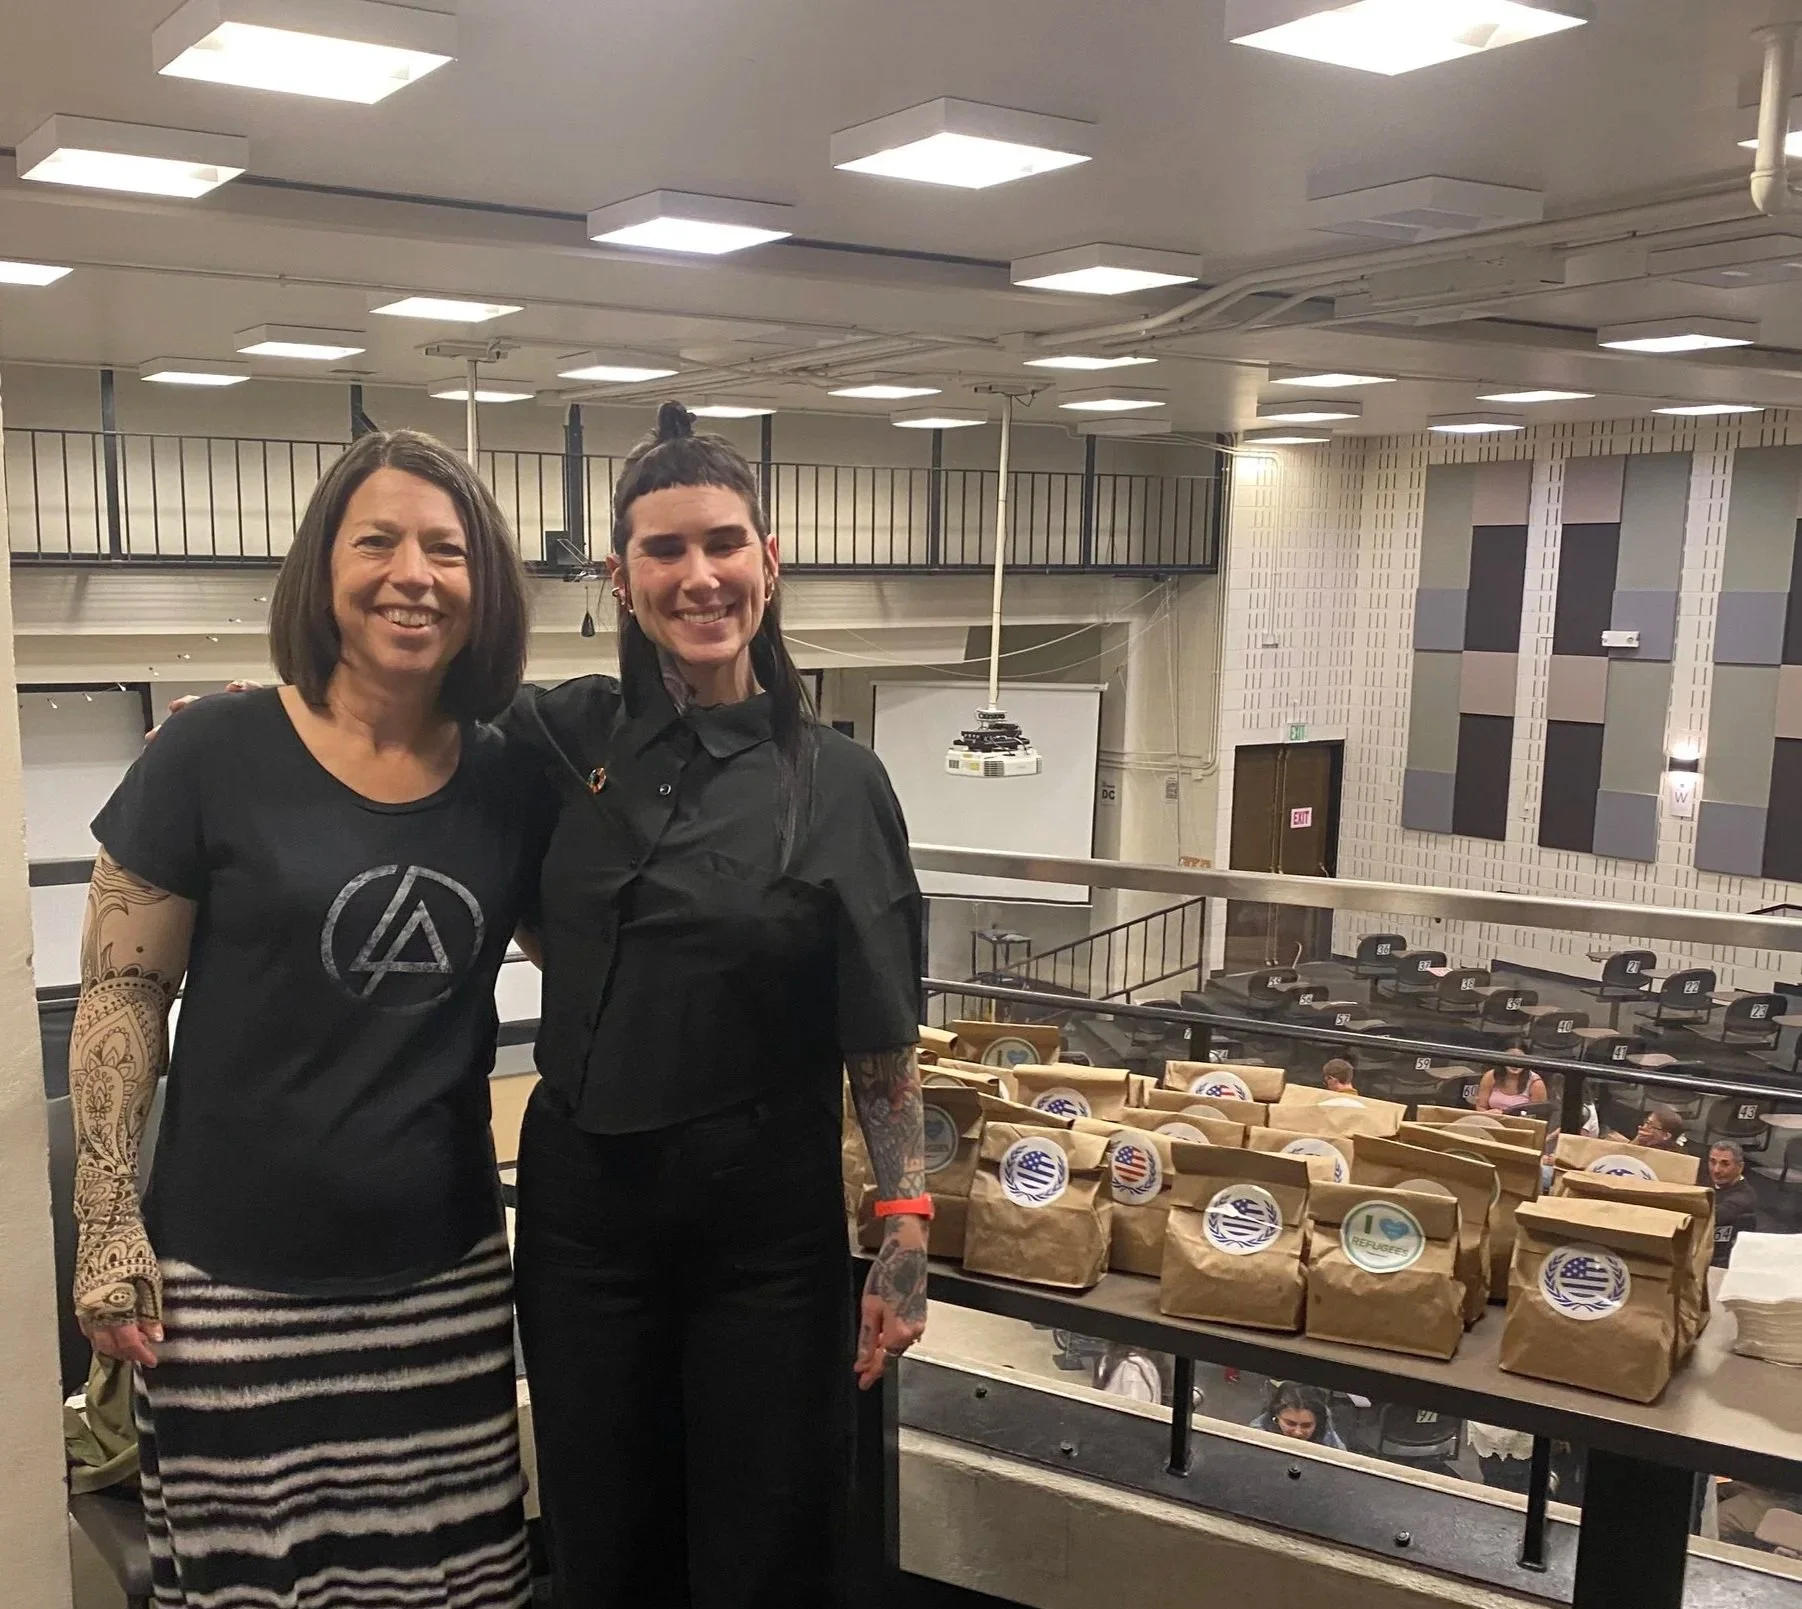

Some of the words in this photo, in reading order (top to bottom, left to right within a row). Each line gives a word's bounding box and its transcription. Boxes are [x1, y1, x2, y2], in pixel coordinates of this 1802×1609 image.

[1101, 789, 1115, 800] DC
[1675, 791, 1688, 803] W
[1293, 810, 1310, 826] EXIT
[1377, 944, 1390, 955] 36
[1419, 961, 1431, 971] 37
[1627, 961, 1639, 973] 21
[1685, 981, 1699, 993] 22
[1751, 1004, 1767, 1017] 23
[1336, 1014, 1351, 1025] 57
[1558, 1021, 1573, 1033] 40
[1416, 1058, 1430, 1069] 59
[1464, 1085, 1478, 1097] 60
[1740, 1105, 1757, 1118] 43
[1364, 1214, 1373, 1235] I
[1351, 1235, 1409, 1257] REFUGEES
